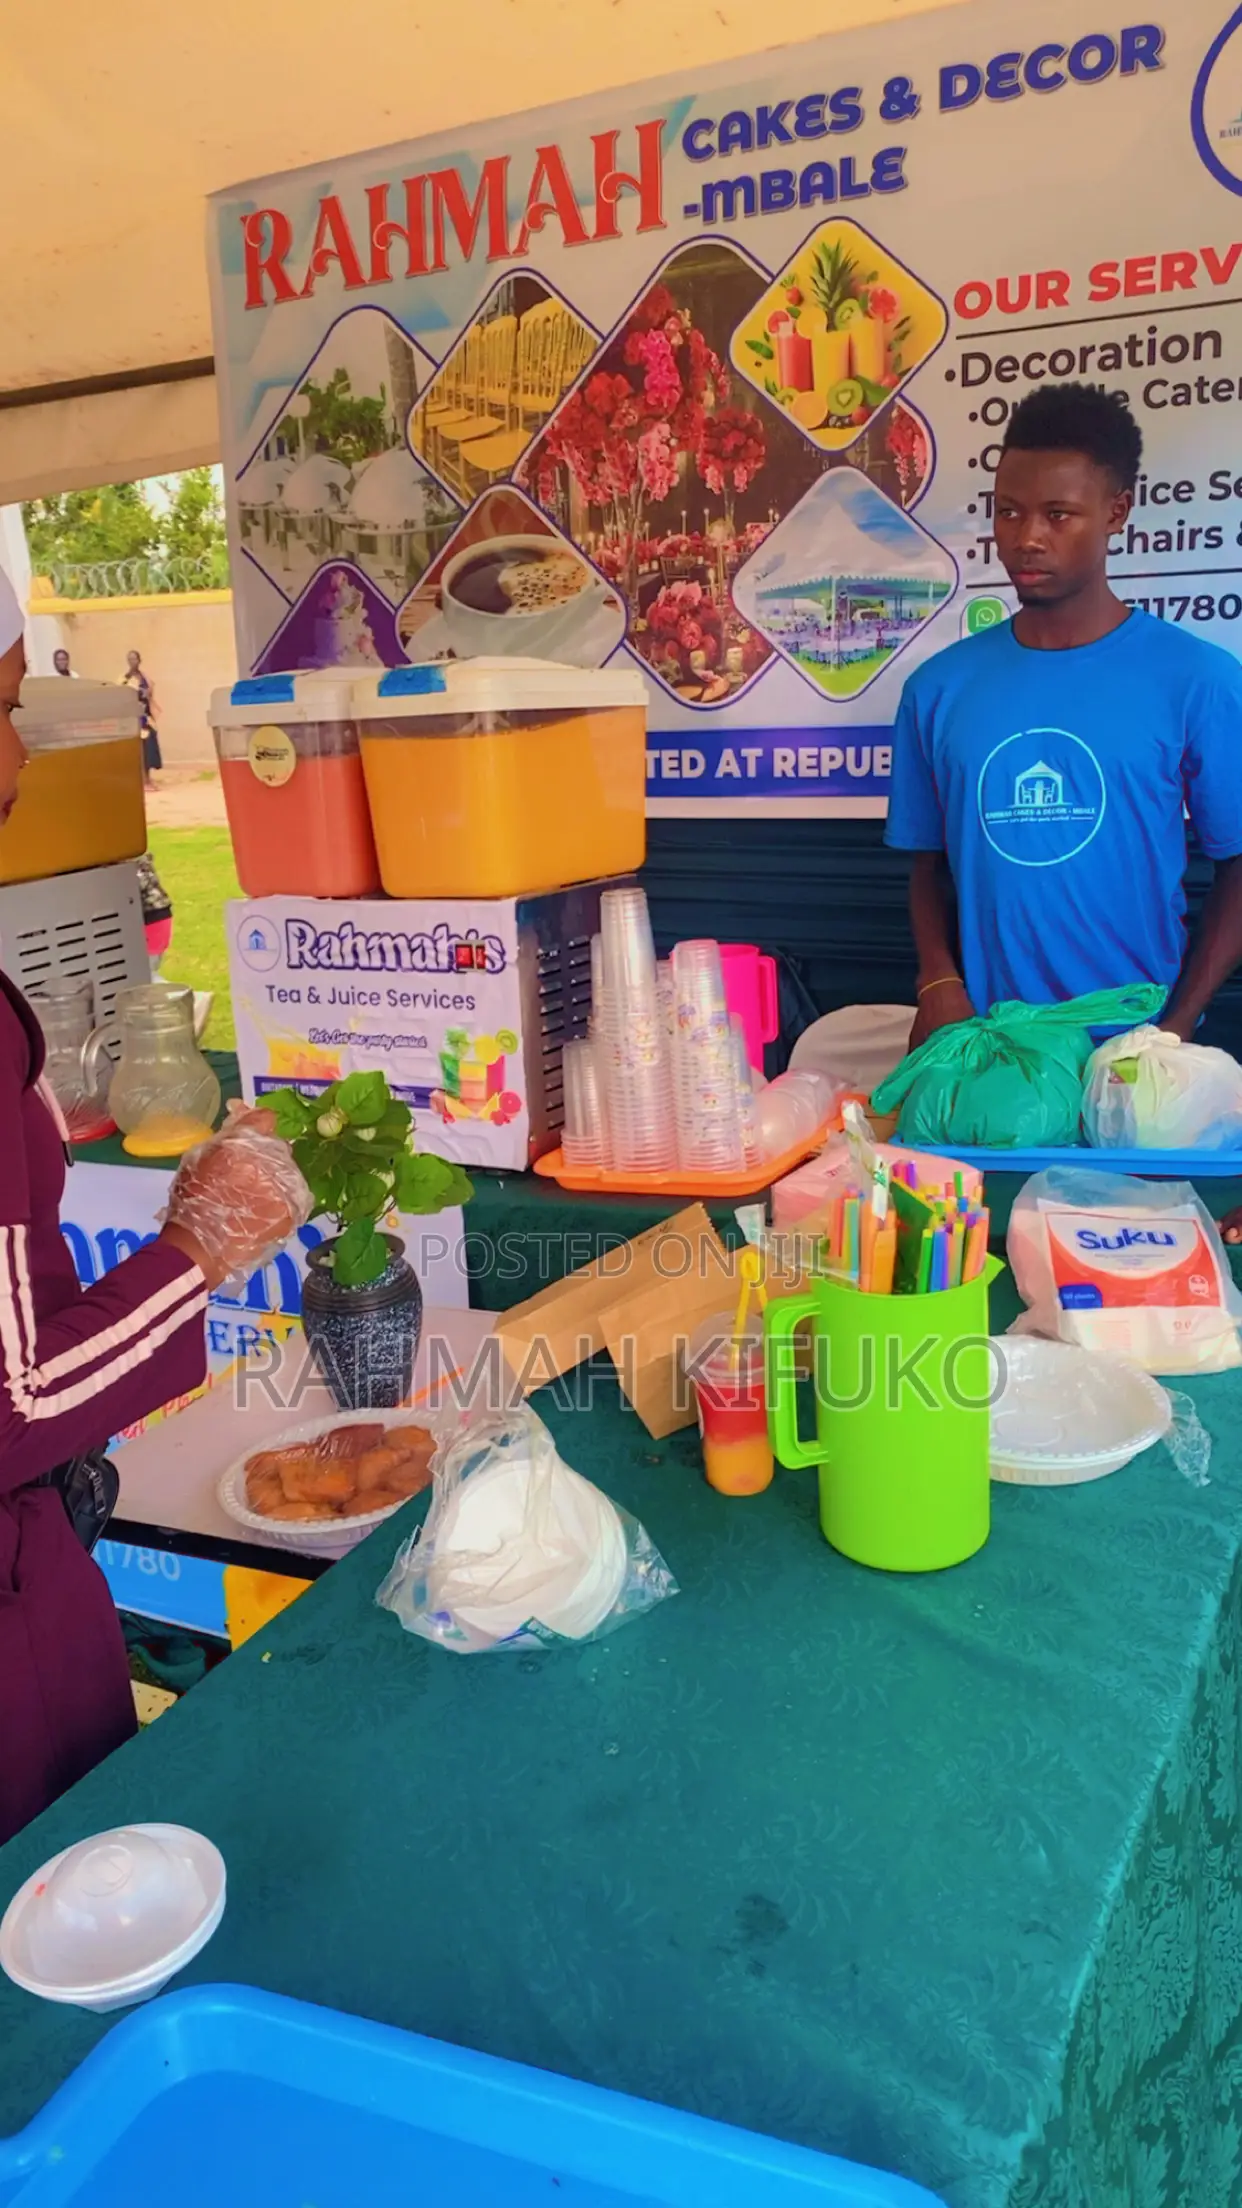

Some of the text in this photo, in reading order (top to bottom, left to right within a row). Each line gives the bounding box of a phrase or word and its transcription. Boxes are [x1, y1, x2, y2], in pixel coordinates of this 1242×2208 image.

[682, 24, 1167, 163] CAKES & DECOR
[683, 146, 908, 224] -MBALE
[240, 119, 668, 311] RAHMAH
[953, 243, 1242, 320] OUR SERV
[961, 325, 1222, 388] Decoration
[1142, 375, 1242, 410] Cate
[1122, 593, 1242, 623] 11780
[714, 748, 763, 779] AT
[265, 984, 476, 1011] Tea & Juice Services
[1076, 1228, 1177, 1251] Suku
